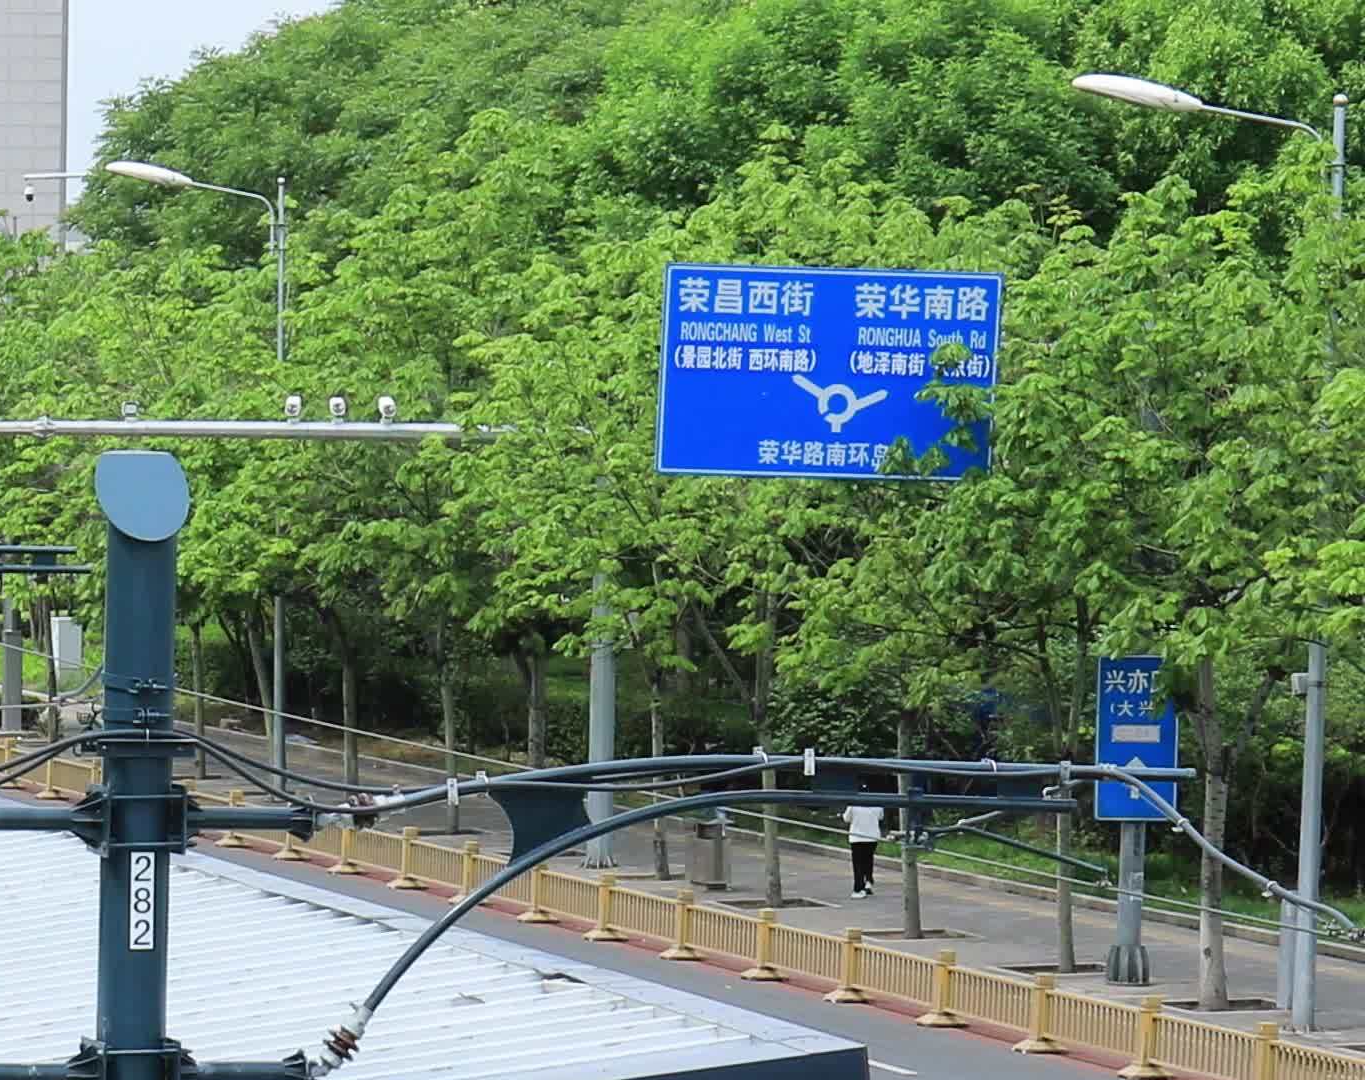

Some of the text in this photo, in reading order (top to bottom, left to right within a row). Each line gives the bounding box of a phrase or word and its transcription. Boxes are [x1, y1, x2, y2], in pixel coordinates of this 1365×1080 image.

[679, 277, 814, 316] 荣昌西街
[855, 283, 989, 321] 荣华南路
[680, 321, 811, 343] RONGCHANG West St
[858, 326, 921, 347] RONGHUA
[970, 329, 987, 349] Rd
[674, 345, 817, 373] (景园北街 西环南路)
[849, 350, 925, 376] (地泽南街
[133, 855, 152, 946] 282
